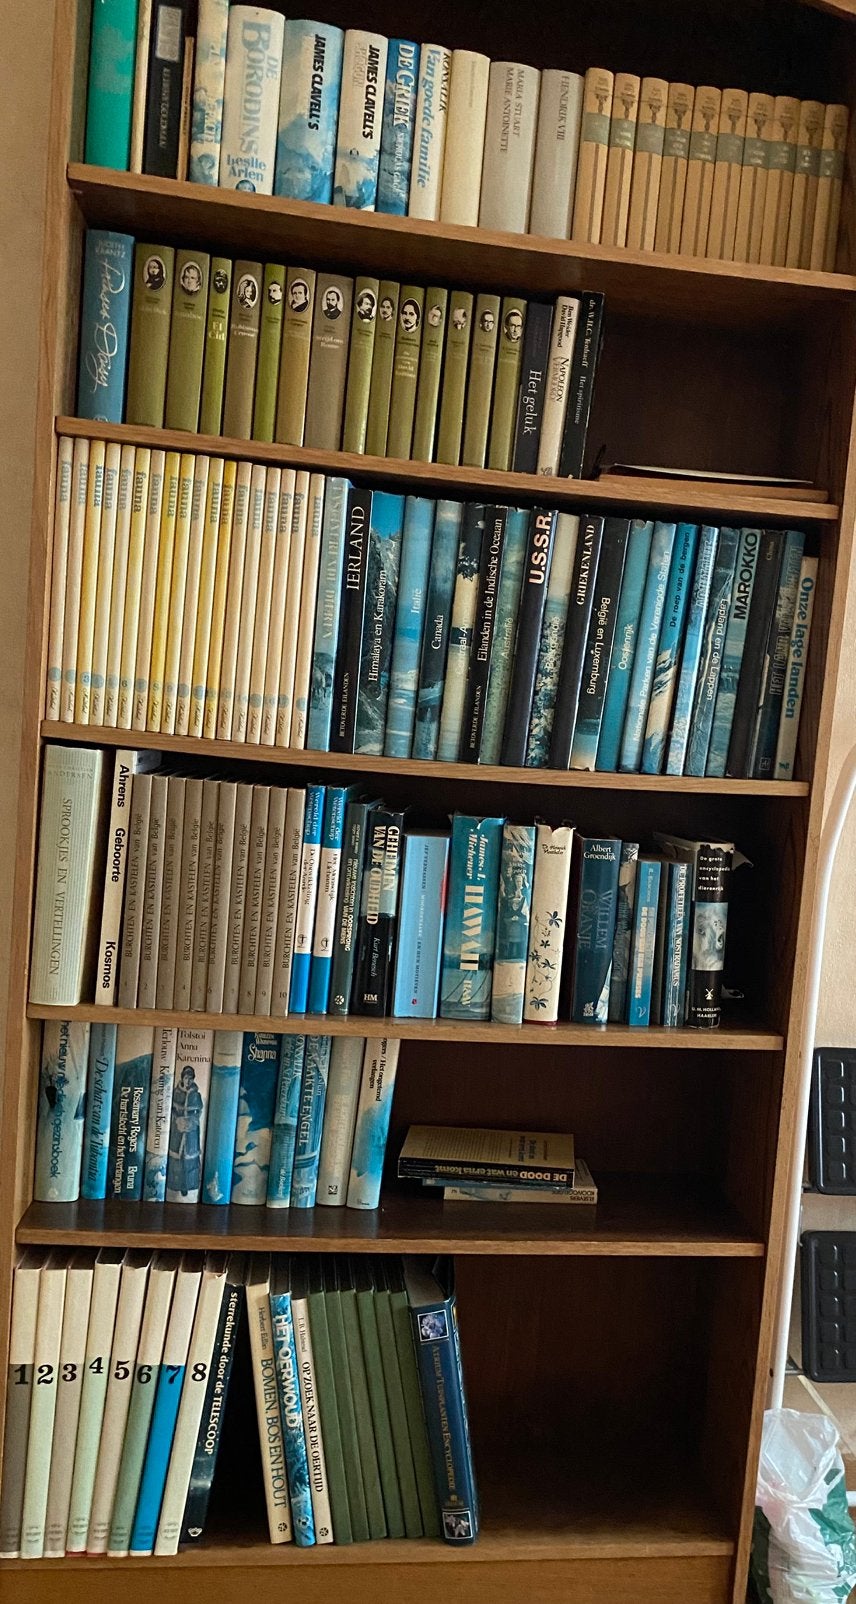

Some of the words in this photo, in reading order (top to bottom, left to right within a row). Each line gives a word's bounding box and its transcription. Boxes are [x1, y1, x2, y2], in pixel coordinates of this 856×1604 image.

[265, 55, 279, 79] DE
[313, 34, 326, 75] JAMES
[366, 45, 380, 85] JAMES
[398, 44, 415, 68] DE
[425, 49, 440, 75] Van
[240, 20, 271, 156] BORODINS
[438, 52, 450, 113] KONSALIK
[504, 67, 514, 95] MARIE
[515, 69, 525, 99] MARIA
[308, 75, 324, 130] CLAVELL'S
[362, 85, 378, 139] CLAVELL'S
[393, 69, 415, 129] GRIEK
[421, 78, 436, 125] goede
[557, 76, 570, 123] HENDRIK
[499, 97, 511, 153] ANTOINETTE
[513, 102, 522, 137] STUART
[556, 124, 566, 141] VIII
[417, 127, 433, 188] familie
[228, 167, 264, 181] Arlen
[560, 304, 568, 321] David
[565, 318, 573, 337] Weider
[557, 322, 566, 348] Hapgood
[528, 369, 541, 393] Het
[556, 357, 569, 402] NAPOLEON
[522, 397, 538, 435] geluk
[574, 389, 584, 425] spiritisme
[134, 471, 146, 513] fauna
[179, 478, 191, 519] fauna
[291, 492, 305, 533] fauna
[347, 506, 365, 590] IERLAND
[492, 519, 502, 553] Oceaan
[529, 512, 552, 584] U.S.S.R.
[681, 533, 690, 559] bergen
[487, 557, 499, 594] Indische
[576, 525, 595, 605] GRIEKENLAND
[658, 551, 669, 580] Staten
[680, 564, 685, 573] de
[734, 533, 757, 620] MAROKKO
[374, 571, 387, 621] Karakoram
[411, 589, 421, 613] Italië
[487, 597, 493, 607] de
[650, 585, 664, 630] Verenigde
[673, 595, 681, 614] roep
[798, 577, 814, 619] Onze
[486, 609, 492, 619] in
[598, 597, 611, 626] België
[670, 616, 676, 627] De
[717, 599, 728, 635] Lapland
[374, 623, 382, 635] en
[432, 615, 444, 650] Canada
[478, 621, 490, 662] Eilanden
[597, 629, 605, 640] en
[649, 633, 656, 645] de
[715, 638, 721, 649] en
[790, 623, 807, 658] lage
[368, 637, 382, 682] Himalaya
[618, 624, 634, 670] Oostenrijk
[712, 652, 719, 664] de
[587, 642, 604, 694] Luxemburg
[639, 665, 649, 699] Parken
[707, 665, 718, 700] Lappen
[785, 661, 801, 718] landen
[339, 702, 347, 737] BETOVERDE
[633, 702, 645, 742] Nationale
[117, 765, 130, 807] Ahrens
[57, 798, 72, 863] SPROOKJES
[373, 826, 386, 849] VAN
[112, 828, 125, 882] Geboorte
[371, 850, 382, 866] DE
[383, 826, 399, 890] GEHEIMEN
[467, 834, 478, 879] Michener
[478, 834, 488, 871] James
[583, 852, 616, 861] Groendijk
[590, 845, 612, 853] Albert
[56, 868, 67, 884] EN
[287, 869, 297, 908] KASTELEN
[367, 868, 381, 924] OUDHEID
[286, 913, 292, 922] EN
[460, 885, 485, 971] HAWAII
[48, 891, 65, 975] VERTELLINGEN
[282, 928, 292, 968] BURCHTEN
[103, 941, 116, 988] Kosmos
[58, 1037, 69, 1073] nieuw
[176, 1053, 211, 1062] Karenina
[179, 1042, 198, 1051] Anna
[248, 1044, 276, 1061] Shanna
[95, 1058, 108, 1076] De
[304, 1052, 318, 1102] NAAKTE
[369, 1060, 377, 1089] verlangen
[92, 1079, 105, 1105] schat
[121, 1086, 130, 1098] De
[376, 1073, 384, 1101] ongetemd
[92, 1105, 100, 1124] van
[118, 1098, 130, 1135] hartstocht
[130, 1086, 143, 1125] Rosemary
[157, 1097, 165, 1112] van
[91, 1126, 103, 1138] de
[118, 1136, 125, 1144] en
[127, 1126, 141, 1152] Rogers
[154, 1114, 166, 1149] Katoren
[298, 1105, 312, 1146] ENGEL
[51, 1118, 62, 1178] gezinsboek
[88, 1140, 103, 1181] Tubantia
[117, 1146, 126, 1157] het
[112, 1158, 124, 1193] verlangen
[126, 1166, 138, 1189] Bruna
[434, 1165, 463, 1174] komt
[487, 1169, 506, 1177] wat
[520, 1172, 551, 1181] DOOD
[552, 1174, 567, 1182] DE
[222, 1292, 238, 1353] sterrekunde
[274, 1314, 288, 1345] HET
[14, 1365, 29, 1385] 1
[37, 1365, 54, 1385] 2
[62, 1364, 77, 1381] 3
[89, 1357, 103, 1374] 4
[114, 1360, 130, 1380] 5
[137, 1365, 152, 1384] 6
[166, 1365, 181, 1384] 7
[192, 1363, 207, 1382] 8
[218, 1356, 229, 1380] door
[302, 1362, 310, 1373] OP
[216, 1381, 224, 1394] de
[278, 1346, 299, 1428] OERWOUD
[304, 1374, 313, 1404] ZOEK
[205, 1395, 223, 1454] TELESCOOP
[267, 1416, 278, 1443] BOS
[307, 1405, 316, 1432] NAAR
[269, 1444, 283, 1463] EN
[309, 1433, 317, 1448] DE
[311, 1449, 322, 1492] OERTIJD
[271, 1464, 287, 1508] HOUT
